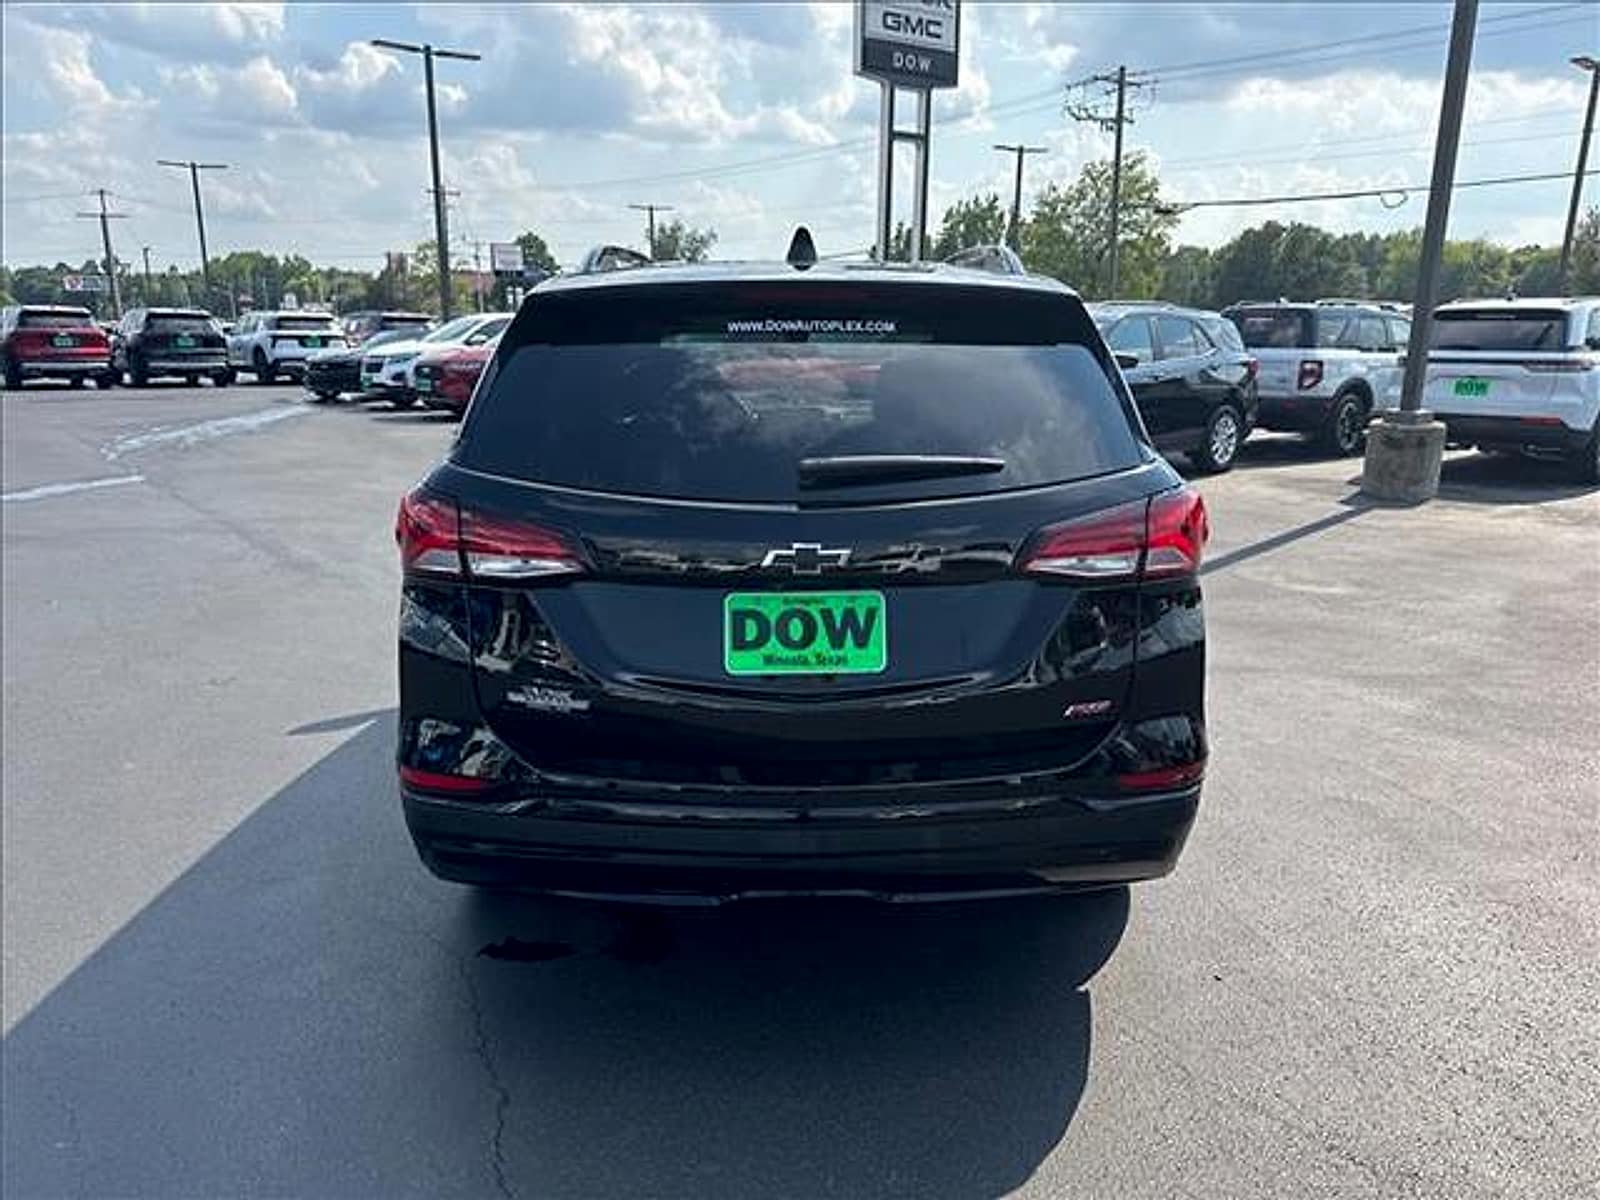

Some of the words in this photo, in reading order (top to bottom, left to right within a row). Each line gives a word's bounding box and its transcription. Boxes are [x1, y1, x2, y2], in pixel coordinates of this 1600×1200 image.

[882, 12, 943, 39] GMC
[892, 52, 932, 72] DOW
[731, 607, 879, 651] DOW
